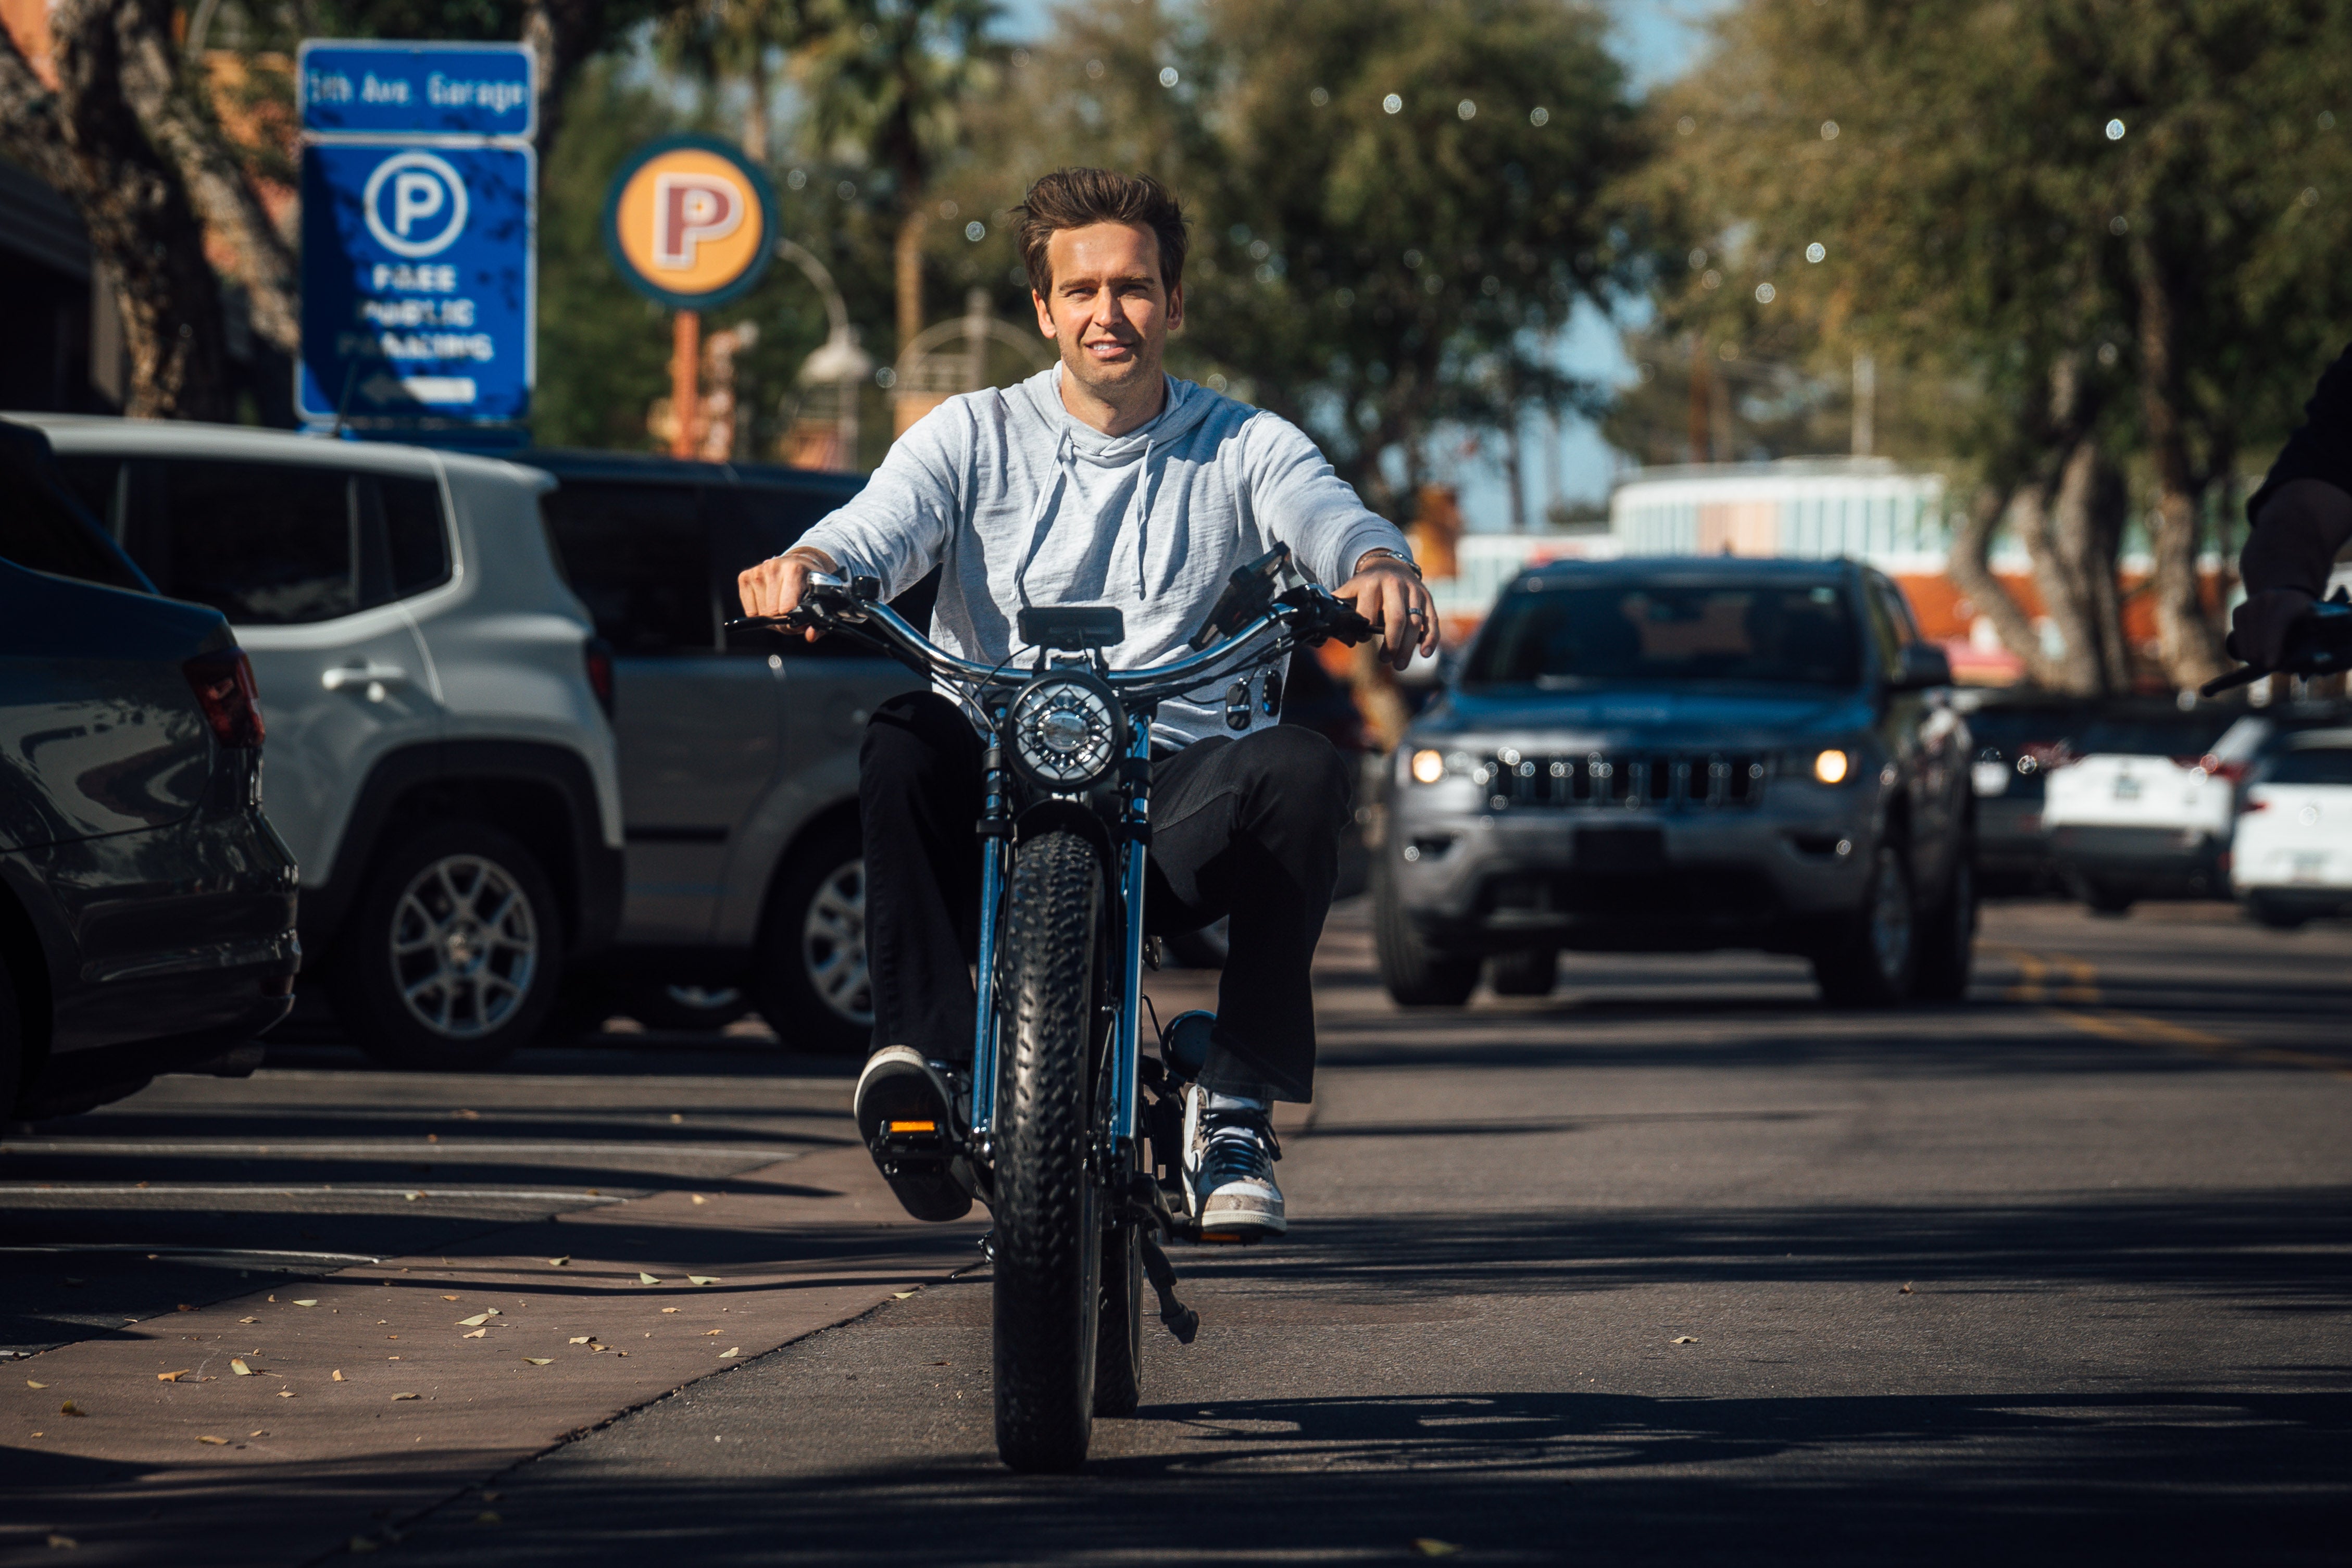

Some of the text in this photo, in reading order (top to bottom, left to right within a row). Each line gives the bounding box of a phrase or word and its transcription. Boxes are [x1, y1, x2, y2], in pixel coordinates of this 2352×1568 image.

[426, 70, 526, 114] Garage
[394, 172, 445, 238] P
[653, 172, 744, 270] P
